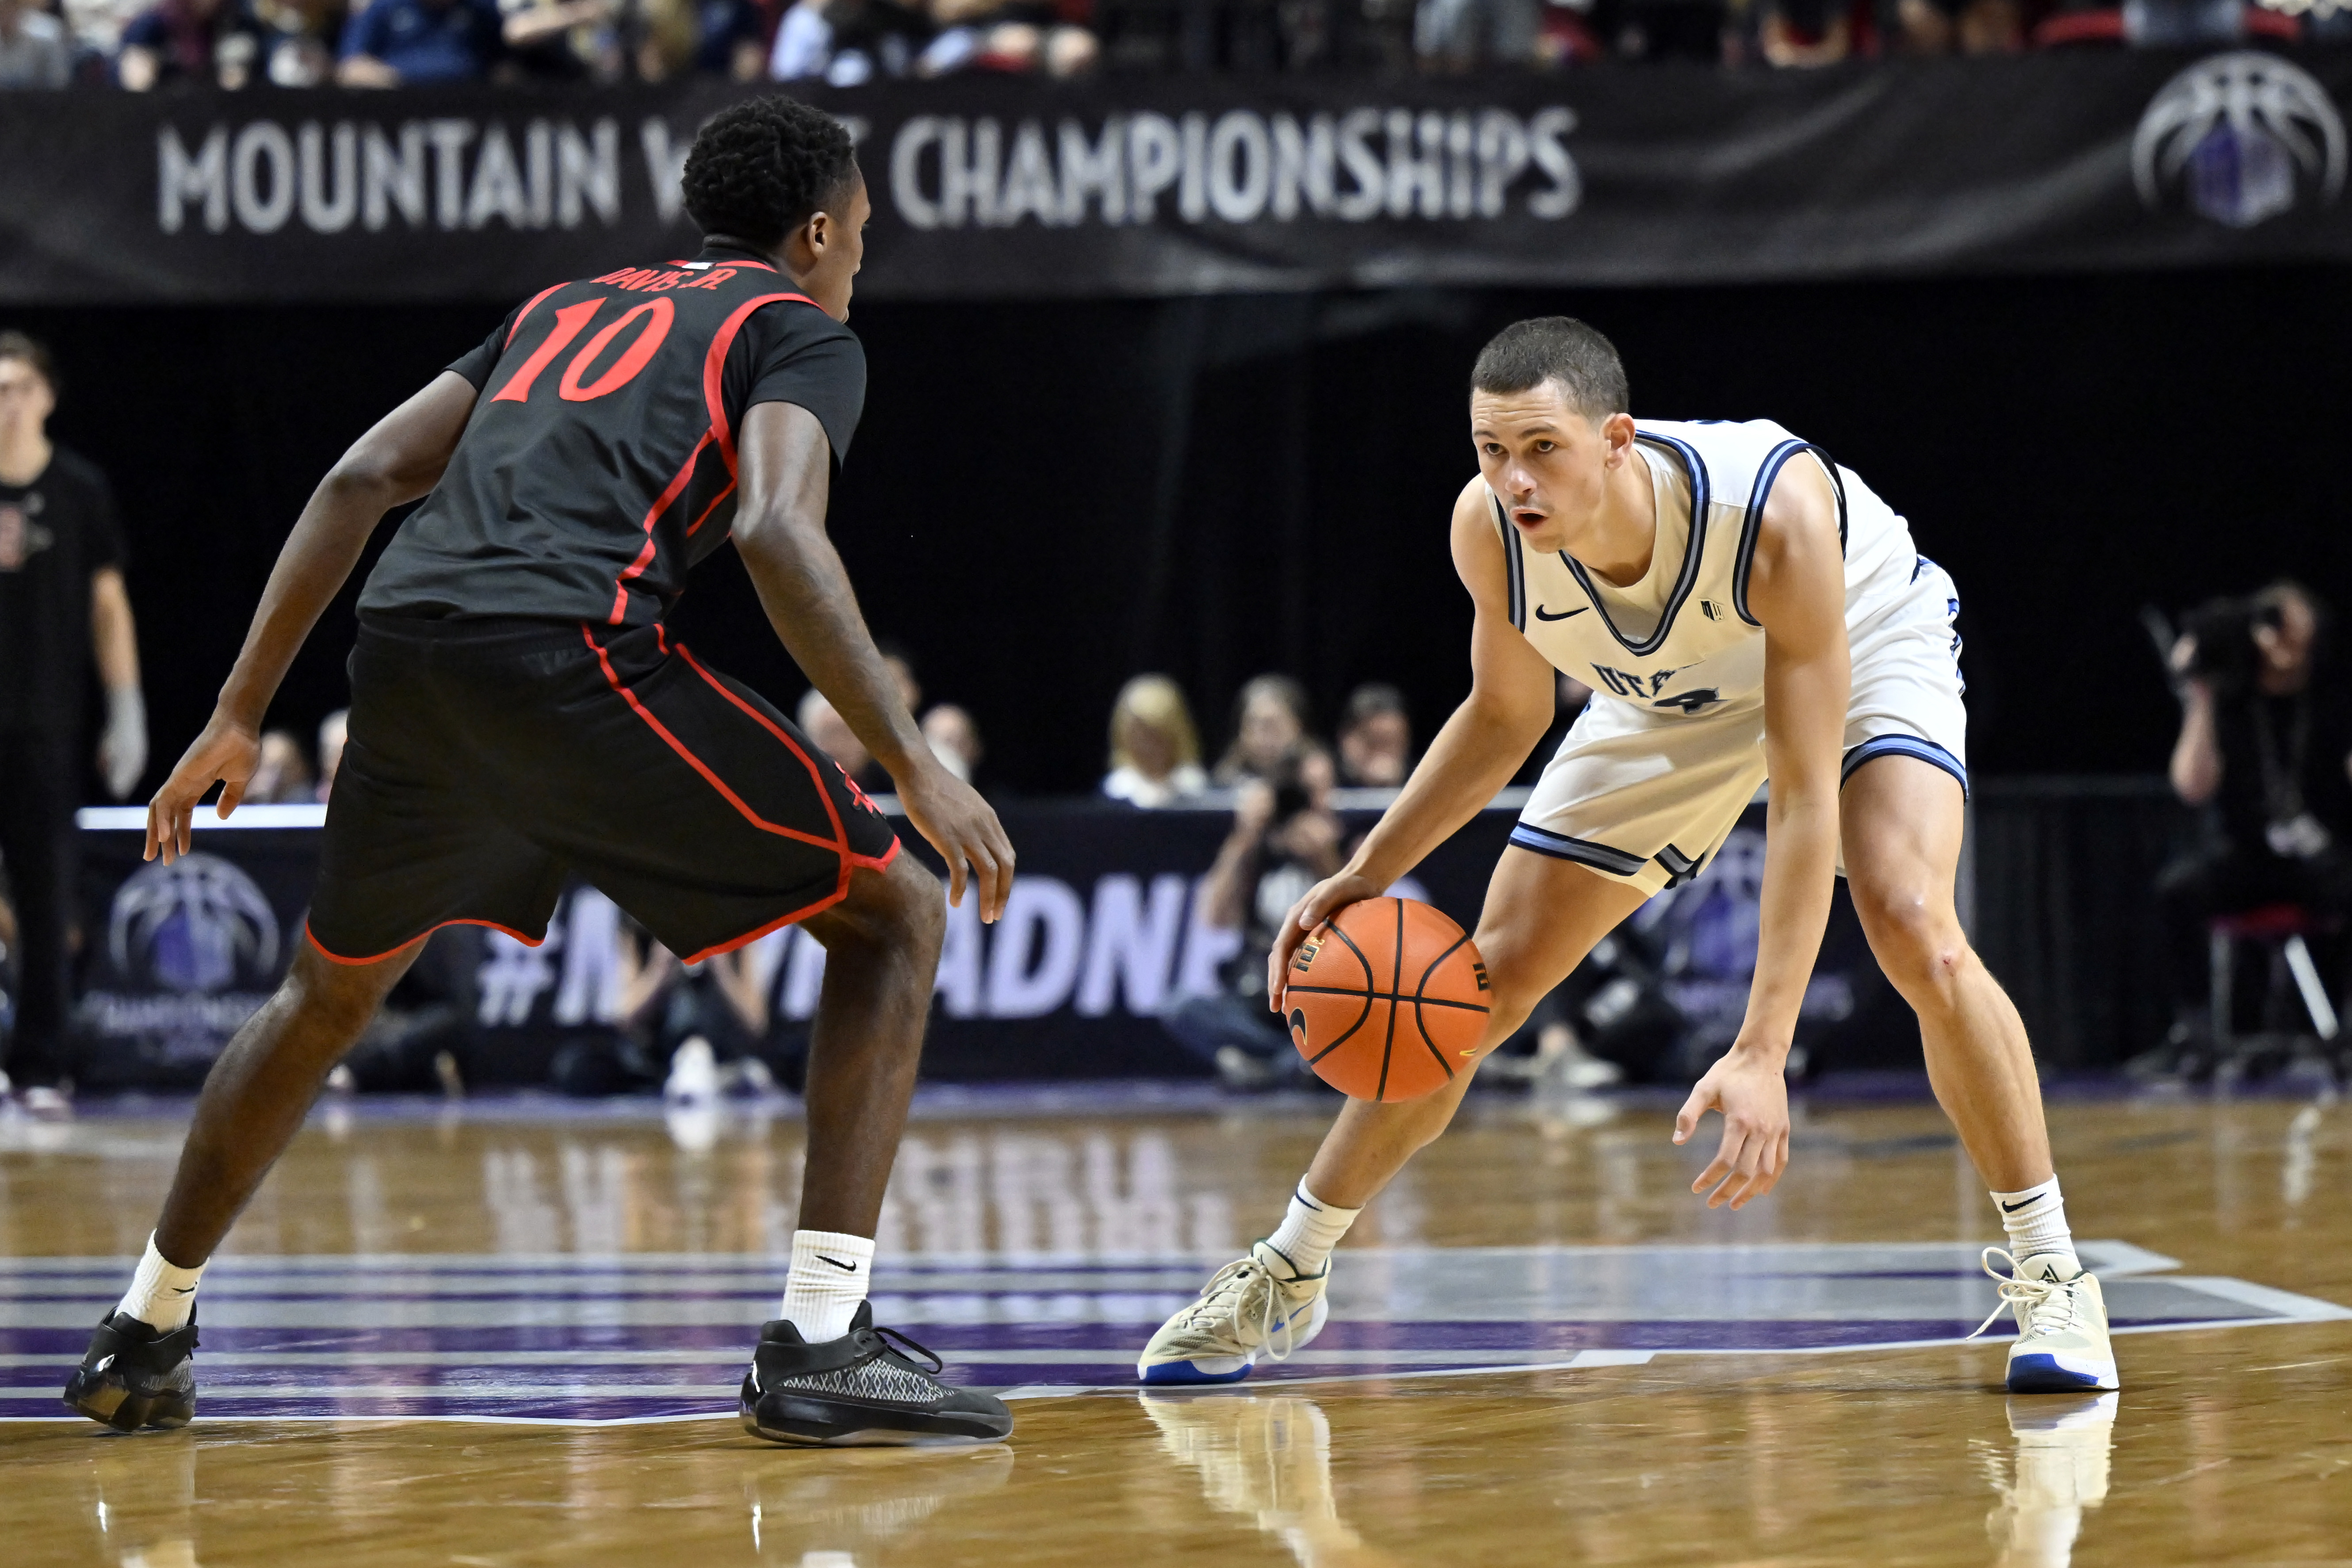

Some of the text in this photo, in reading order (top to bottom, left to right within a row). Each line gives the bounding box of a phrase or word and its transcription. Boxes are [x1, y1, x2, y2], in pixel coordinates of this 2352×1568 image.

[157, 117, 621, 234] MOUNTAIN
[888, 106, 1581, 230] CHAMPIONSHIPS
[490, 297, 675, 403] 10
